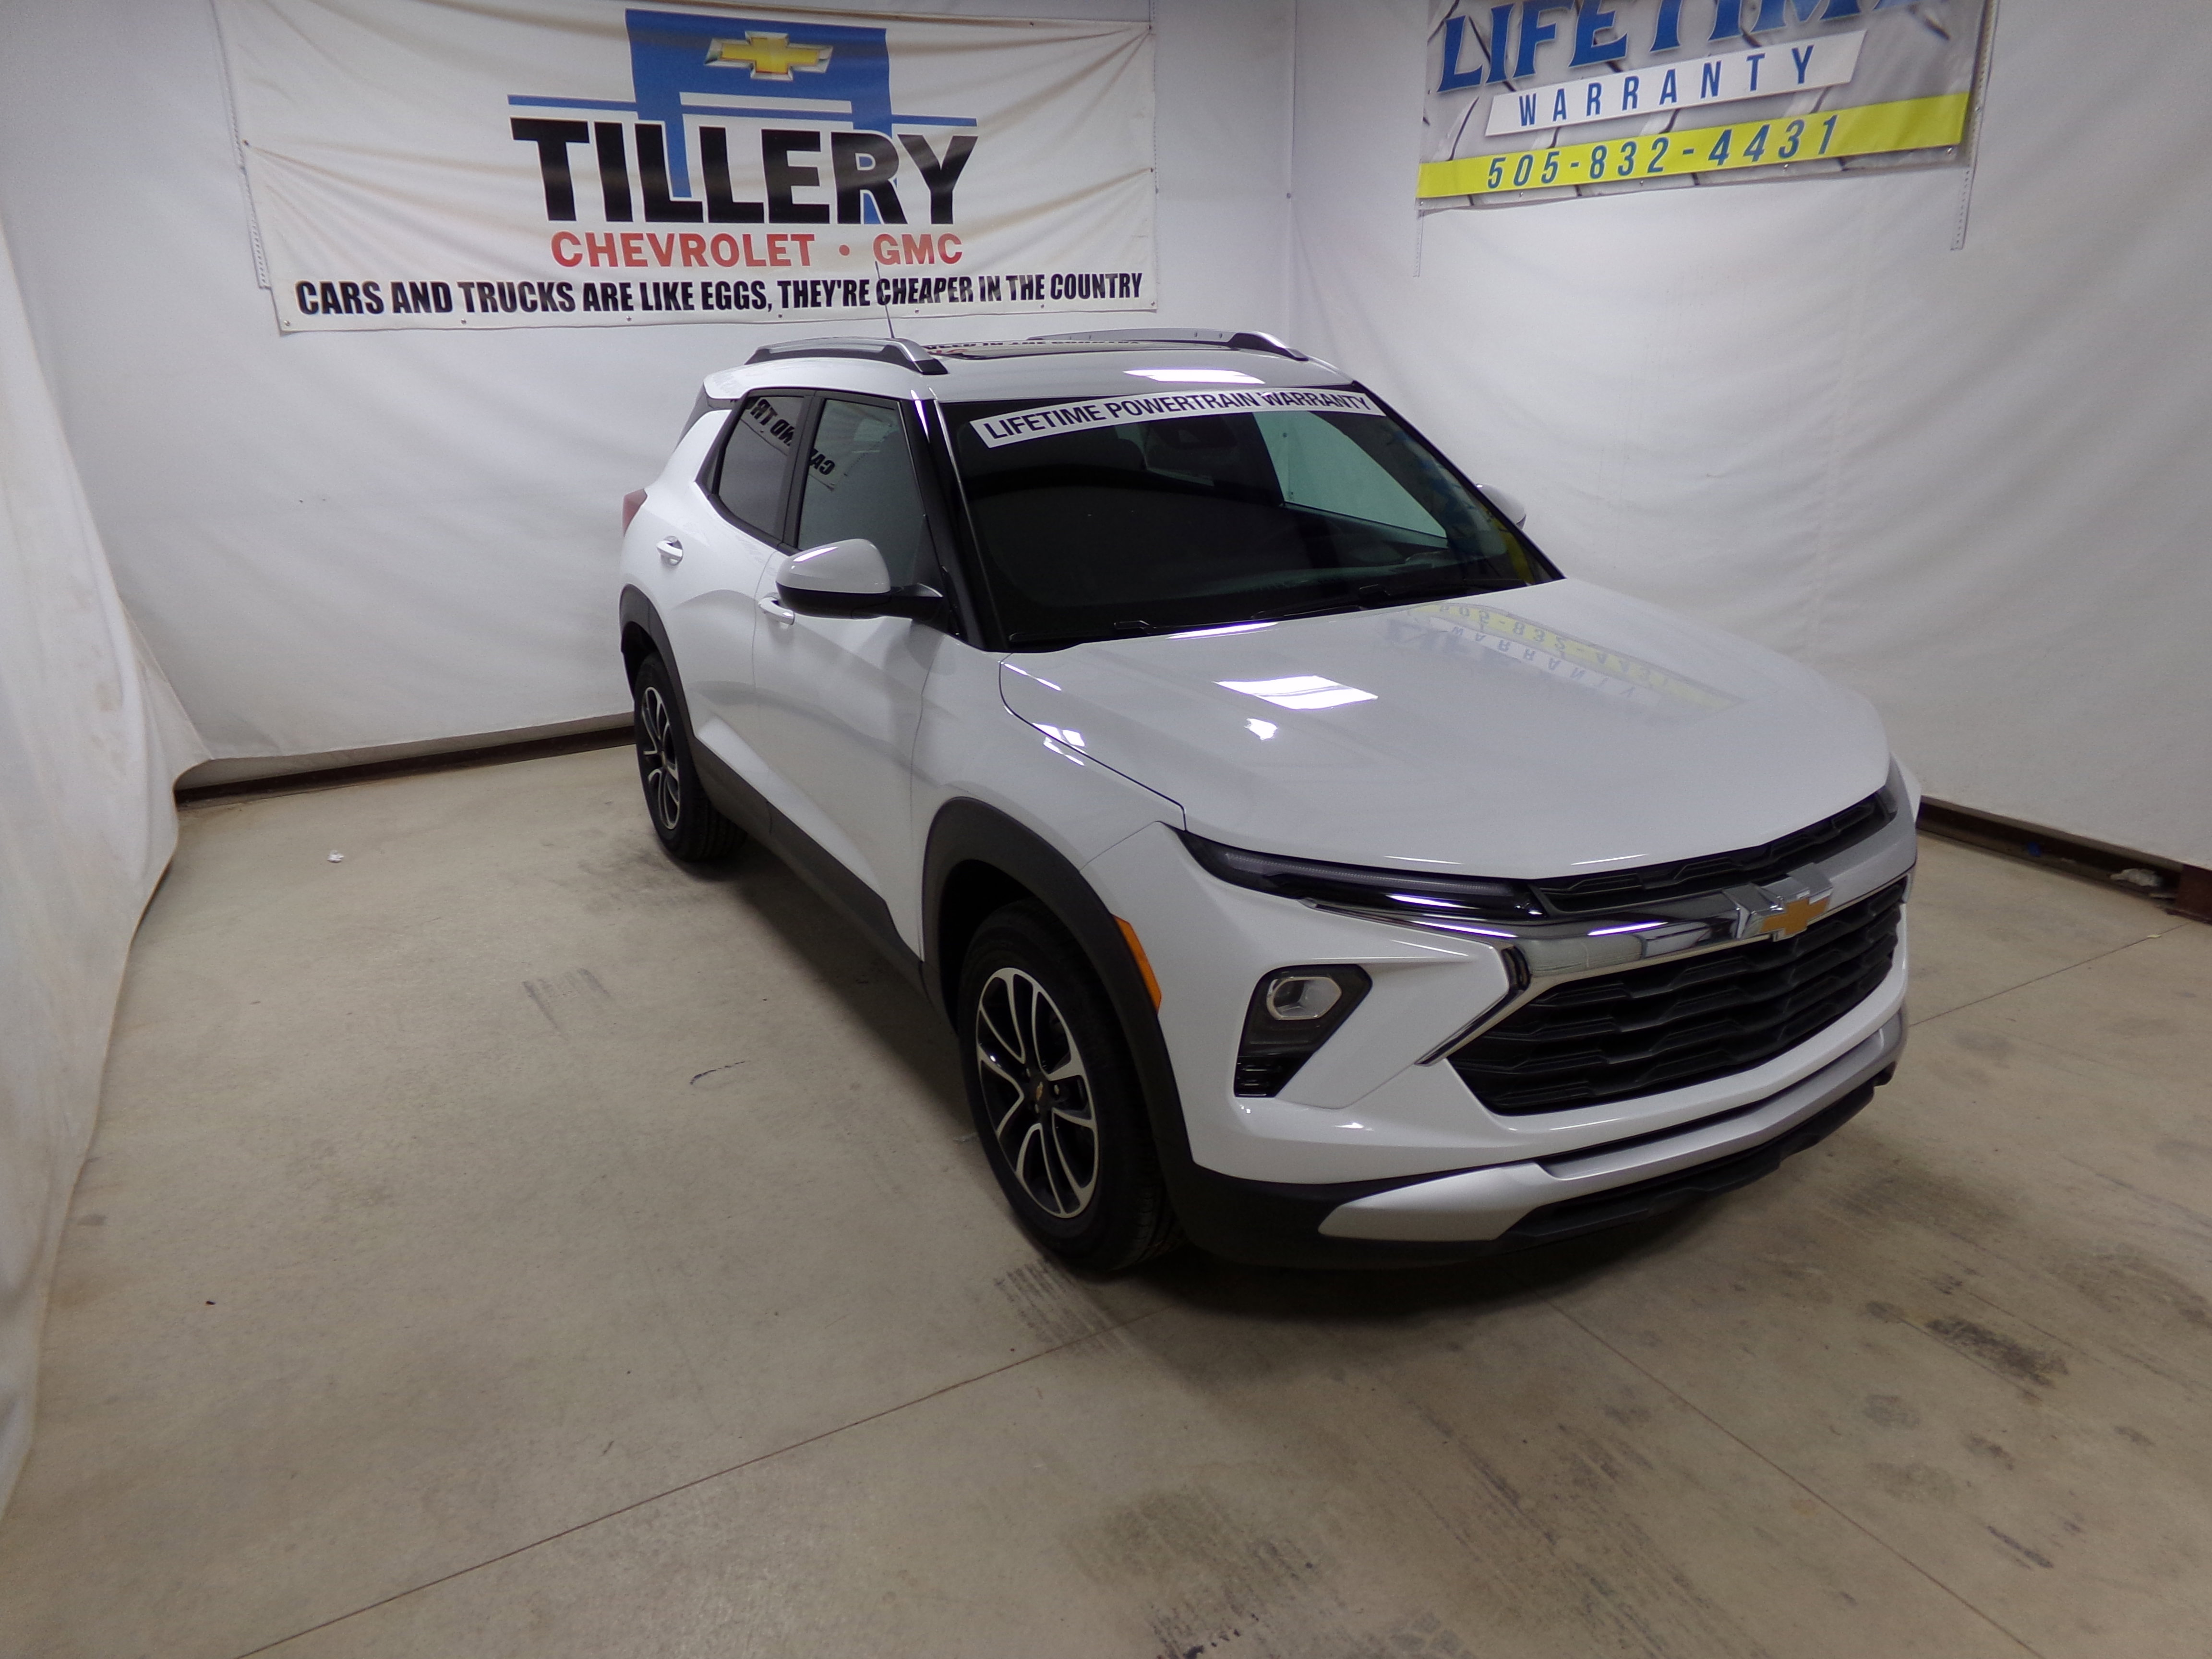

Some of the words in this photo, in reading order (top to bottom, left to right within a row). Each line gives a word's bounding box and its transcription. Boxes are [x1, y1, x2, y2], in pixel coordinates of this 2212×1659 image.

[1518, 45, 1814, 127] WARRANTY
[510, 117, 978, 225] TILLERY
[1488, 115, 1838, 189] 505-832-4431
[551, 231, 815, 268] CHEVROLET
[873, 233, 963, 265] GMC
[296, 281, 384, 315] CARS
[391, 282, 453, 313] AND
[457, 281, 576, 313] TRUCKS
[583, 282, 634, 312] ARE
[639, 282, 695, 311] LIKE
[701, 280, 772, 313] EGGS,
[777, 279, 871, 309] THEY'RE
[876, 276, 974, 306] CHEAPER
[978, 276, 1001, 302] IN
[1006, 275, 1045, 301] THE
[1050, 273, 1142, 300] COUNTRY
[983, 405, 1107, 440] LIFETIME
[1107, 392, 1261, 419] POWERTRAIN
[1261, 392, 1371, 410] WARRANTY
